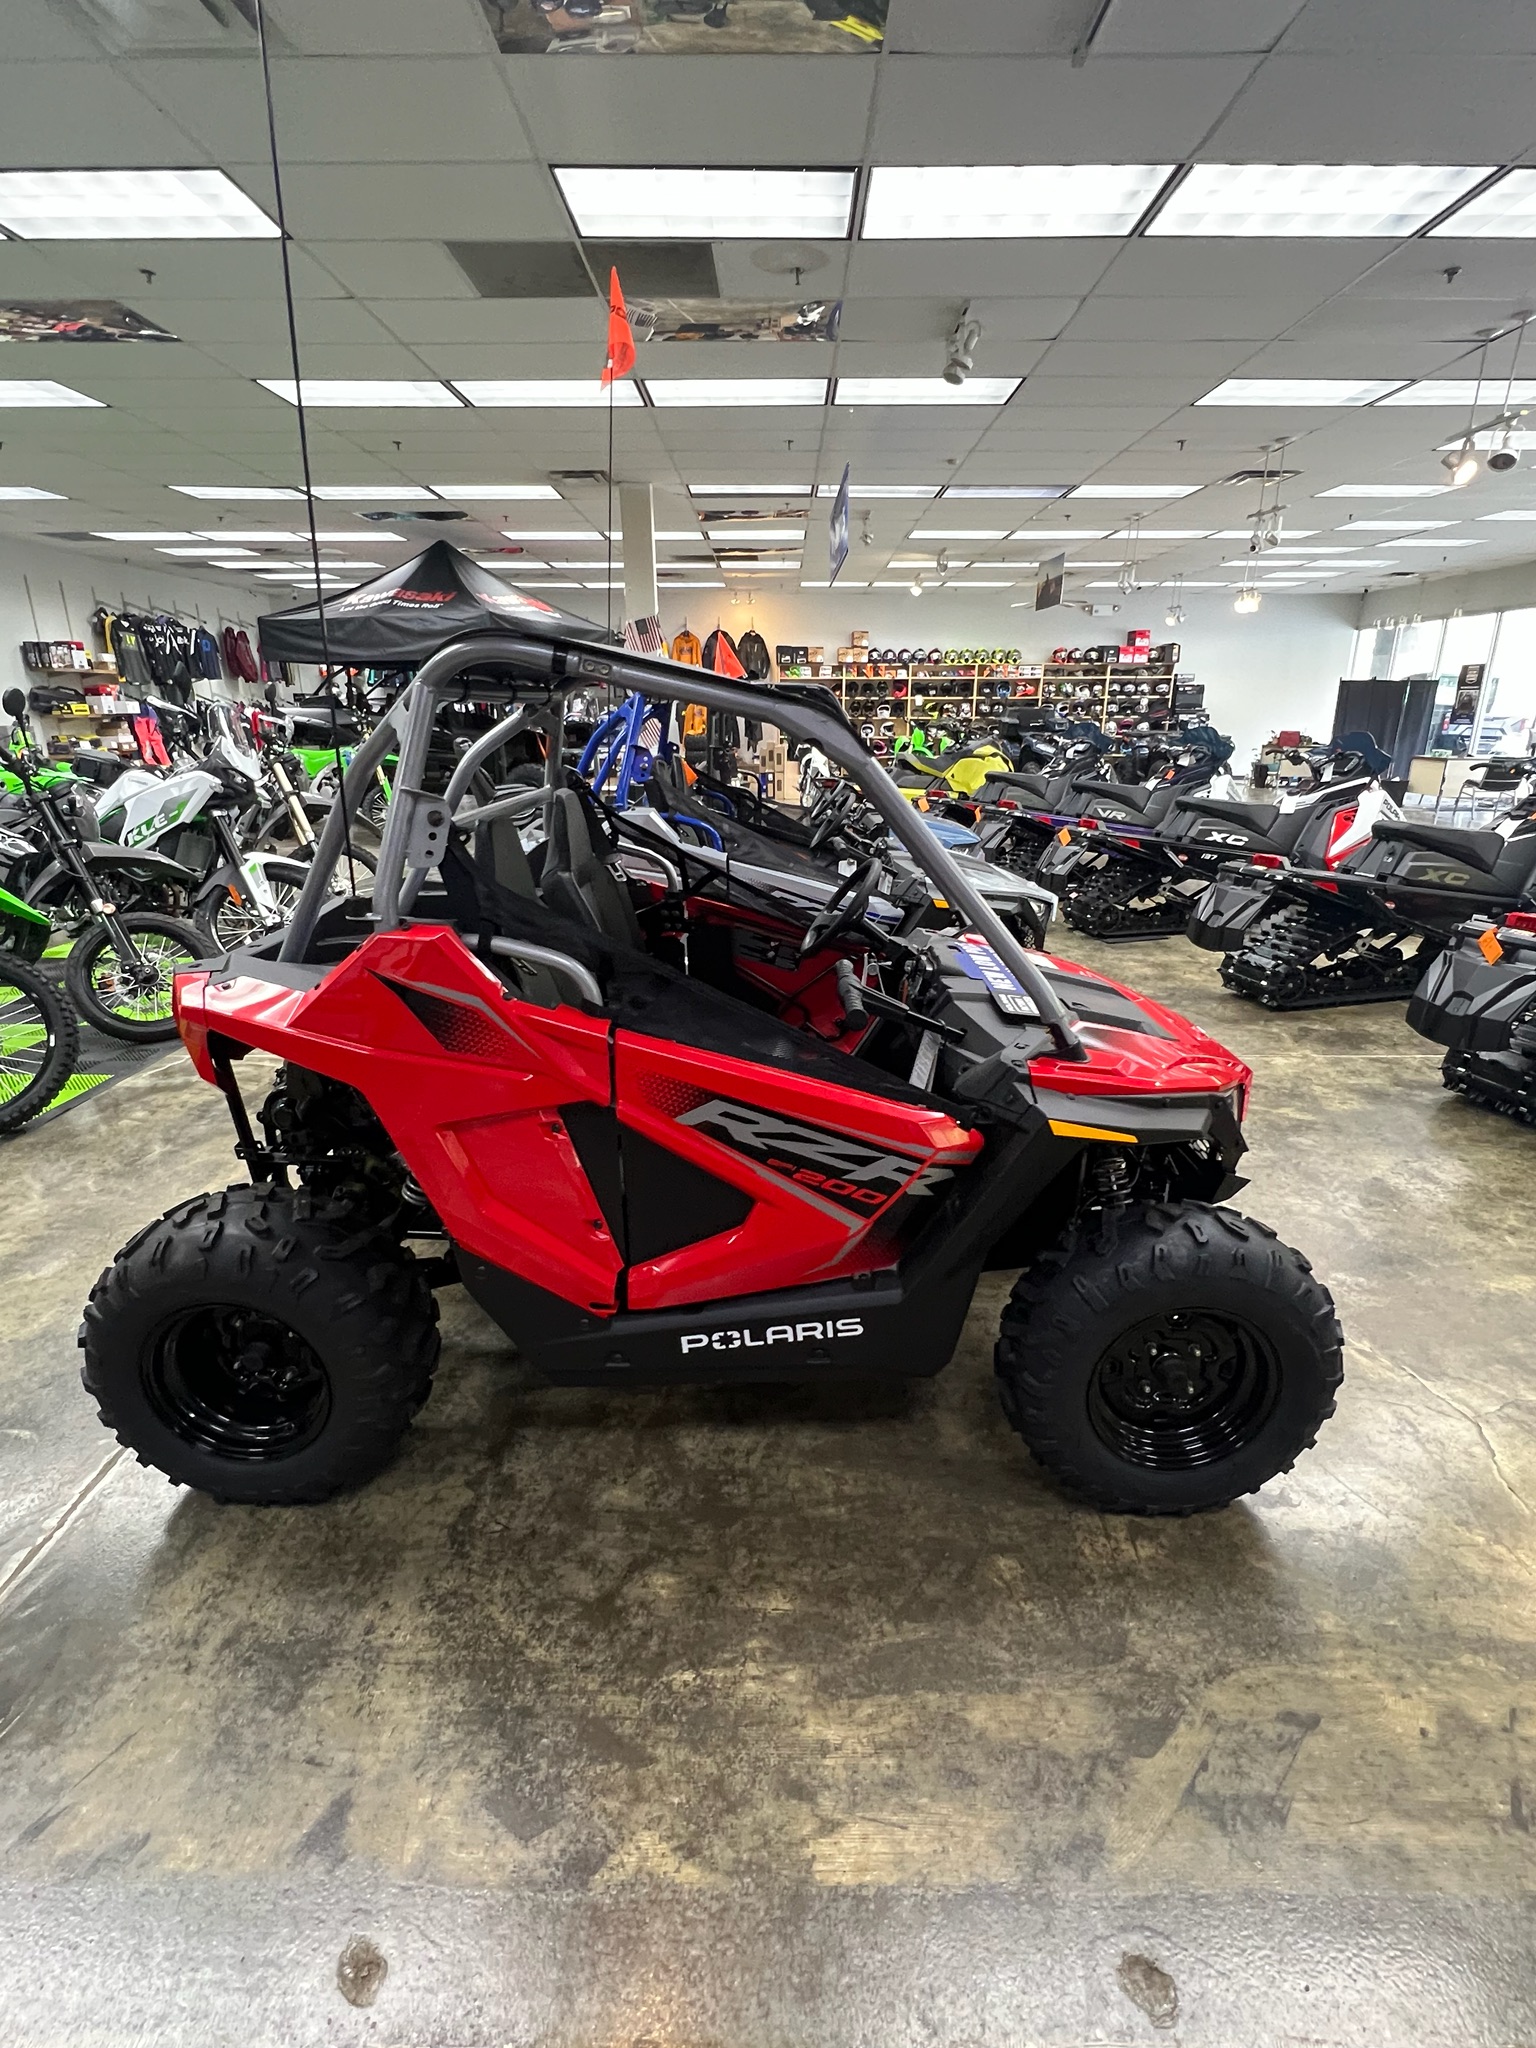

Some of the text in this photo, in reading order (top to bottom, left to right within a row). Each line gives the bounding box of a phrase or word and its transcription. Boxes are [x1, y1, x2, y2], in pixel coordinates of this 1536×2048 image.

[392, 599, 420, 609] Times
[1205, 831, 1249, 846] XC
[1418, 868, 1471, 886] XC
[673, 1099, 955, 1196] RZR
[680, 1318, 864, 1354] POLARIS
